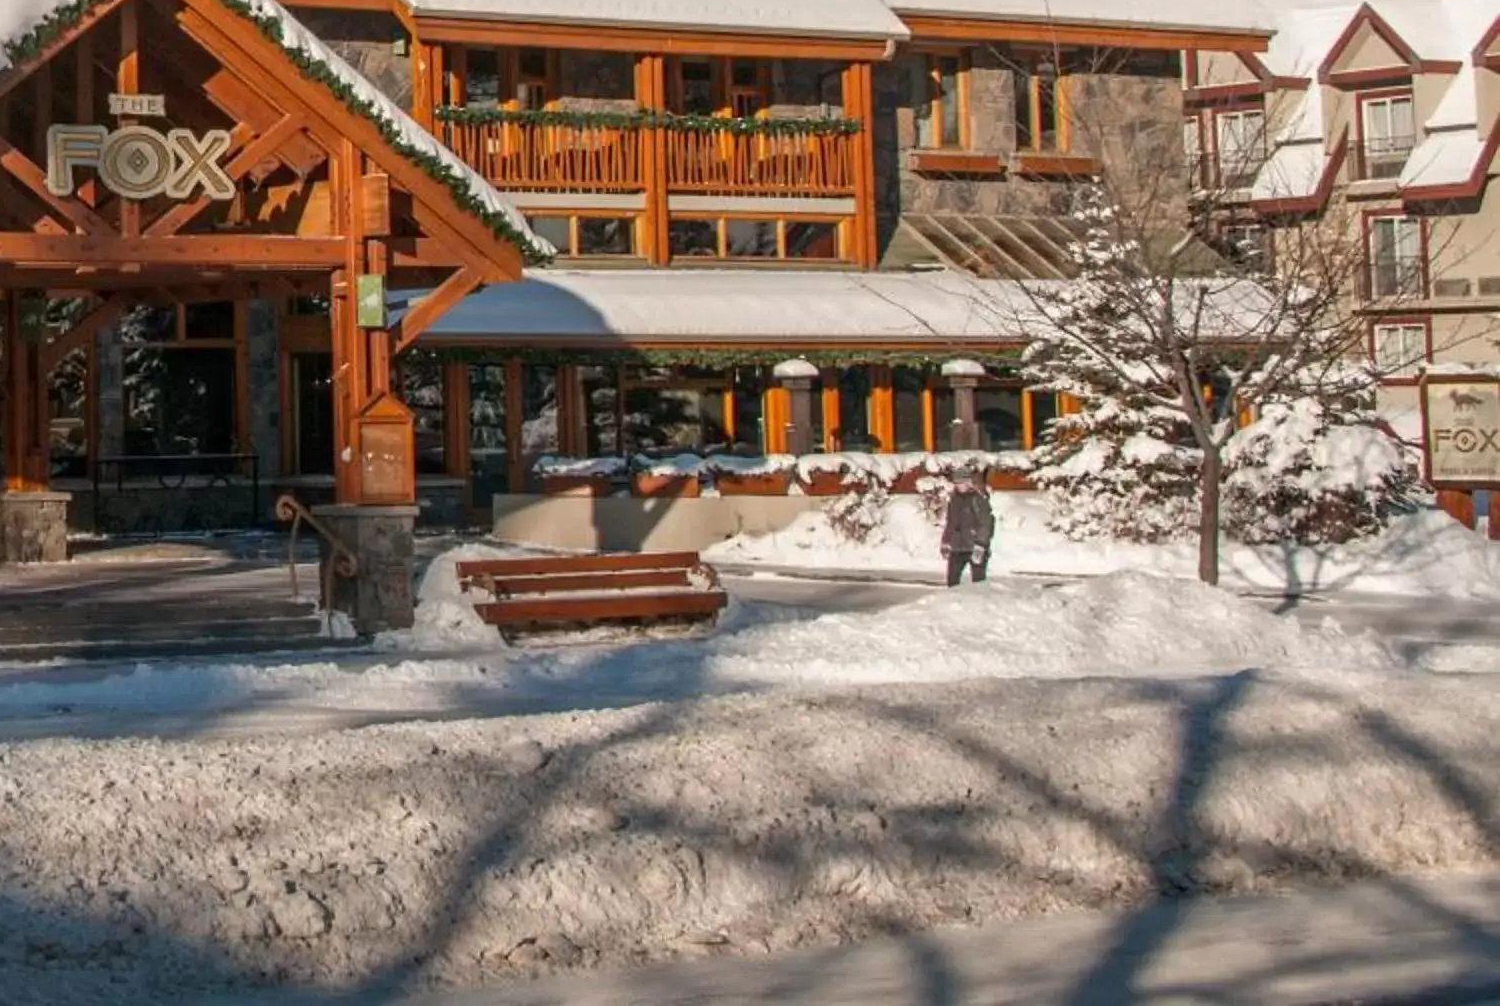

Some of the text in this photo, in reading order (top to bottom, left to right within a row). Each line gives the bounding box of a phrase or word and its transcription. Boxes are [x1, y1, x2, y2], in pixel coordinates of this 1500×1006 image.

[113, 96, 161, 113] THE
[47, 124, 236, 199] FOX
[1433, 428, 1500, 453] FOX
